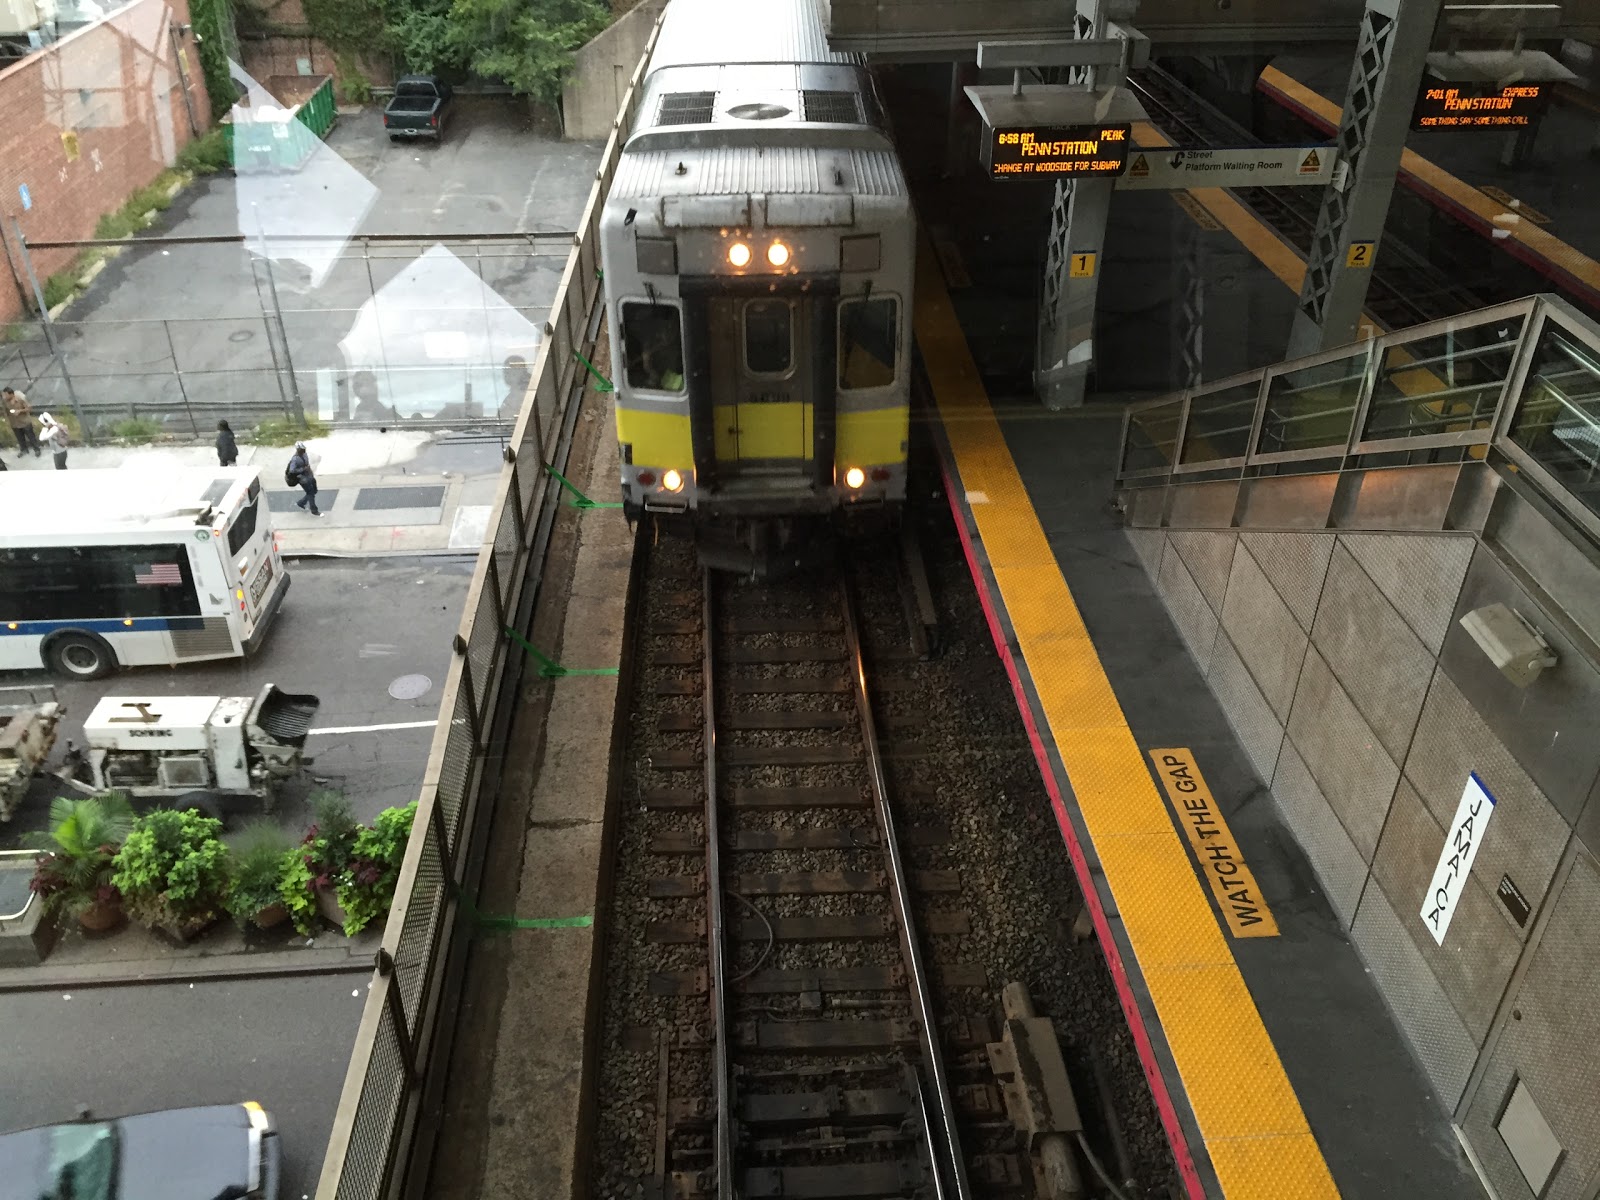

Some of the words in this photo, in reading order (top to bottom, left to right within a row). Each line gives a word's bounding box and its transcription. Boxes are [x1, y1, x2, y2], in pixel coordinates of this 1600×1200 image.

[1445, 89, 1459, 99] AM
[1502, 87, 1539, 97] EXPRESS
[1444, 98, 1472, 110] PENN
[1472, 98, 1513, 110] STATION
[999, 133, 1019, 144] 6:58
[1020, 133, 1035, 144] AM
[1101, 130, 1125, 141] PEAK
[1021, 142, 1052, 156] PENN
[1053, 140, 1098, 155] STATION
[1187, 151, 1213, 159] Street
[1023, 163, 1034, 172] AT
[1035, 162, 1073, 171] WOODSIDE
[1074, 161, 1089, 171] FOR
[1091, 160, 1121, 170] SUBWAY
[1185, 160, 1221, 171] Platform
[1223, 161, 1255, 172] Waiting
[1257, 161, 1283, 170] Room
[1354, 245, 1367, 261] 2
[1079, 255, 1087, 271] 1
[1162, 755, 1198, 793] GAP
[1183, 798, 1220, 840] THE
[1428, 799, 1483, 931] JAMAICA
[1205, 845, 1263, 927] WATCH
